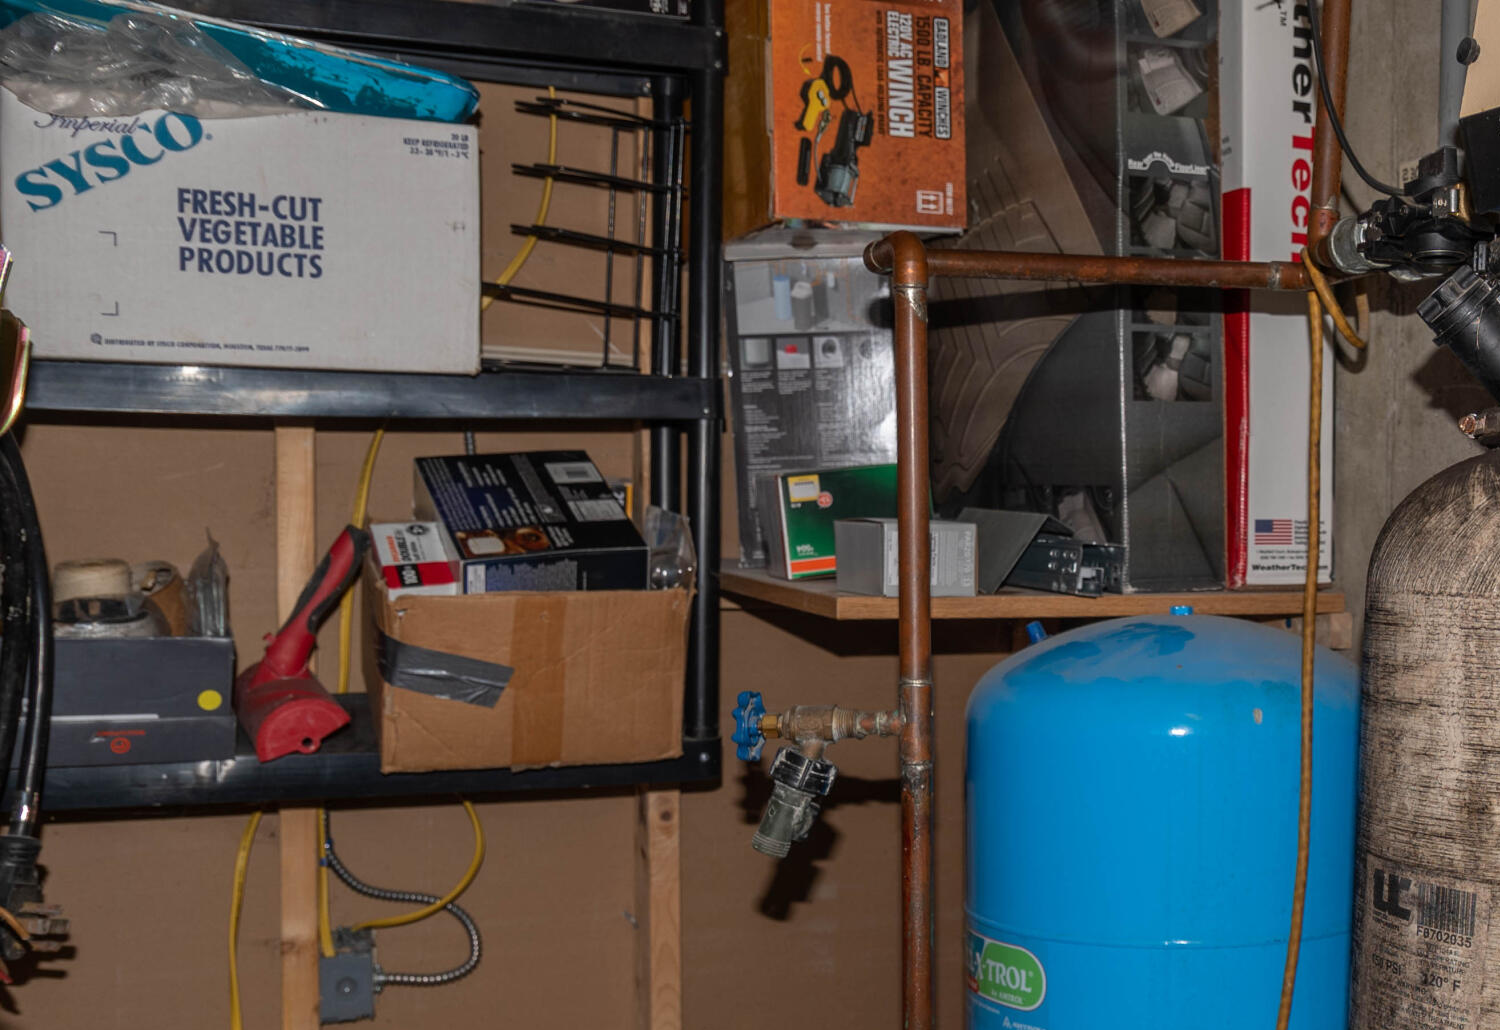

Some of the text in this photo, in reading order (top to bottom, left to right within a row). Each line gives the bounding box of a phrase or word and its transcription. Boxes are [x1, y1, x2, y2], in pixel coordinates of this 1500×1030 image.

[887, 11, 900, 57] ELECTRIC
[900, 14, 913, 58] 120V AC
[916, 16, 930, 46] 1500
[935, 20, 949, 136] BADLAND WINCHES
[888, 60, 915, 137] WINCH
[918, 75, 932, 137] CAPACITY
[34, 114, 140, 138] Imperial
[177, 187, 323, 222] FRESH-CUT
[177, 216, 324, 250] VEGETABLE
[179, 246, 322, 278] PRODUCTS
